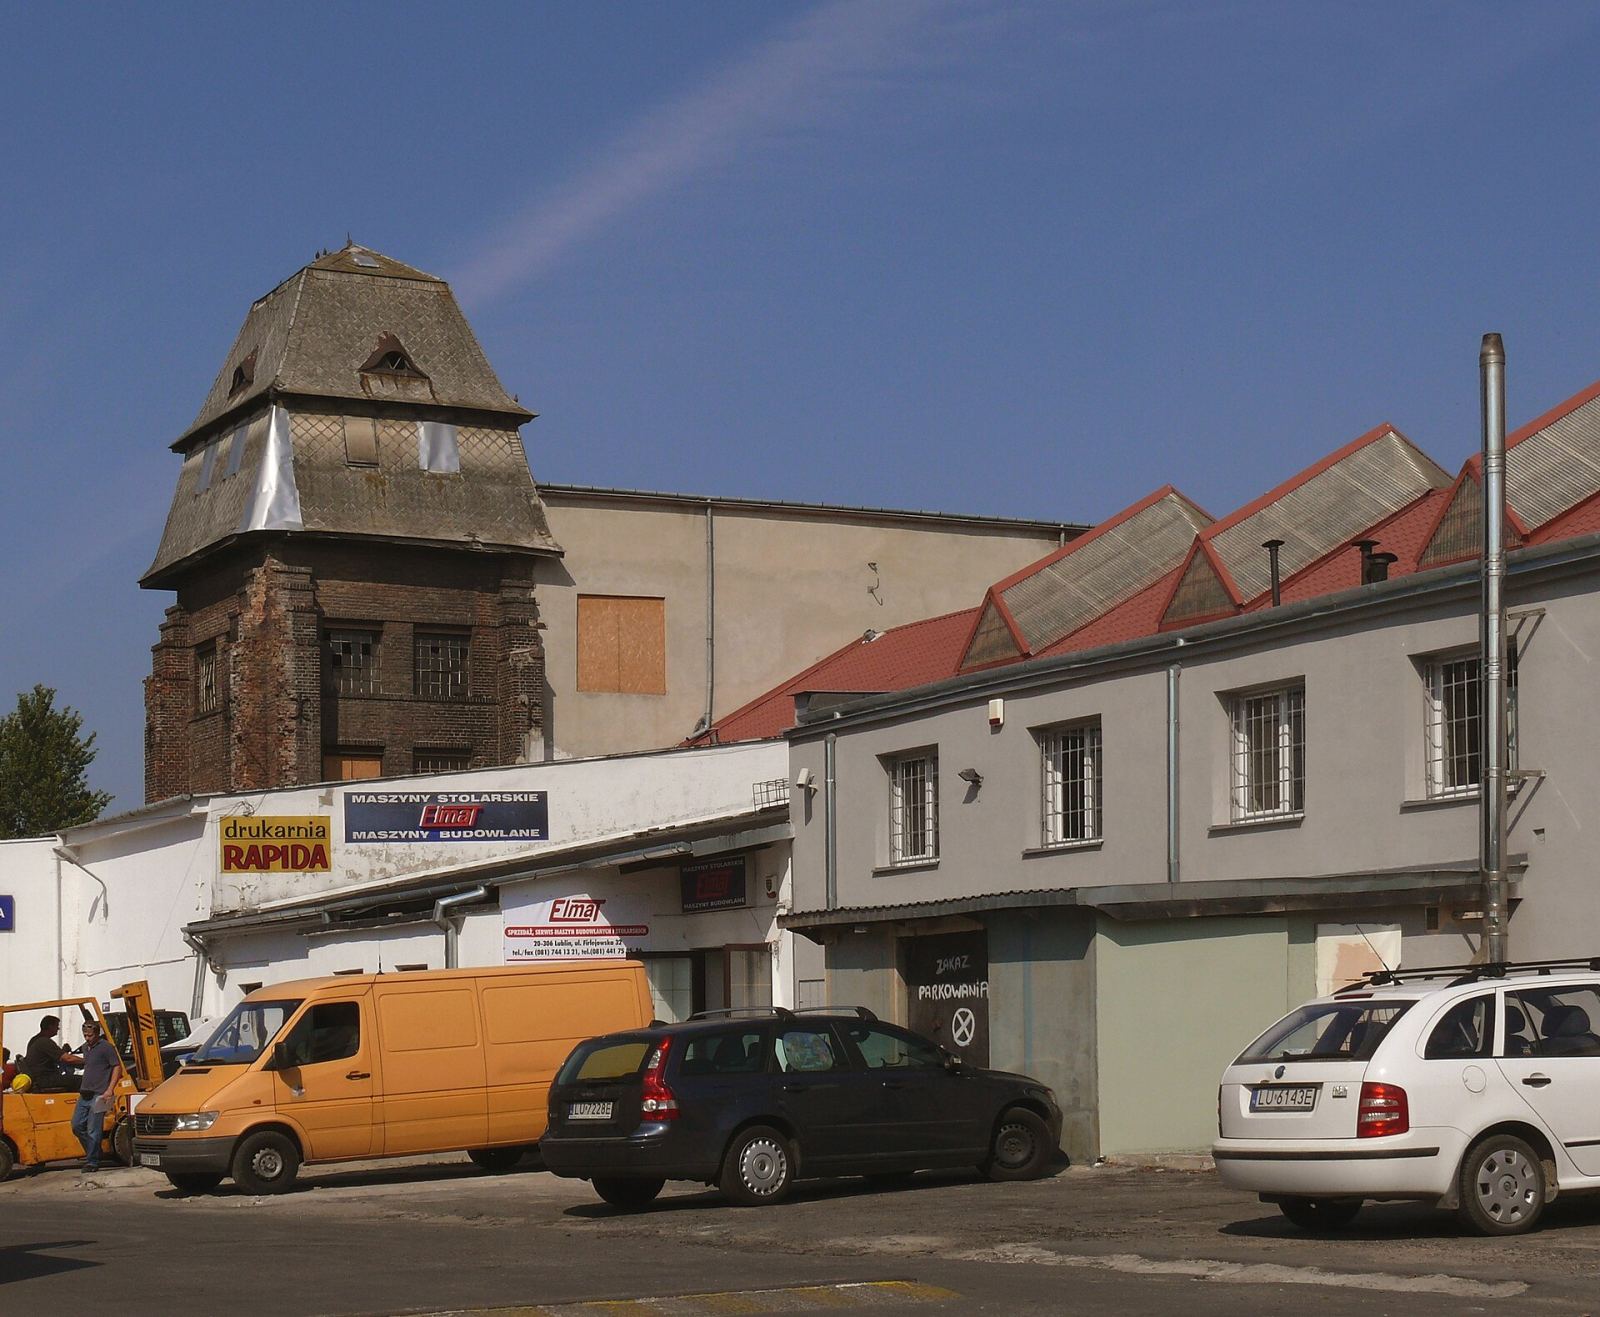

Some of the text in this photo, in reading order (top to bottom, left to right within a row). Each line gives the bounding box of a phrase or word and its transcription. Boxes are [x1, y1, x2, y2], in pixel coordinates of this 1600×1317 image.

[351, 793, 539, 803] MASZYNY STOLARSKIE
[224, 819, 327, 838] drukarnia
[352, 828, 540, 840] MASZYNY BUDOWLANE
[223, 843, 329, 870] RAPIDA
[936, 955, 971, 975] ZAKAZ
